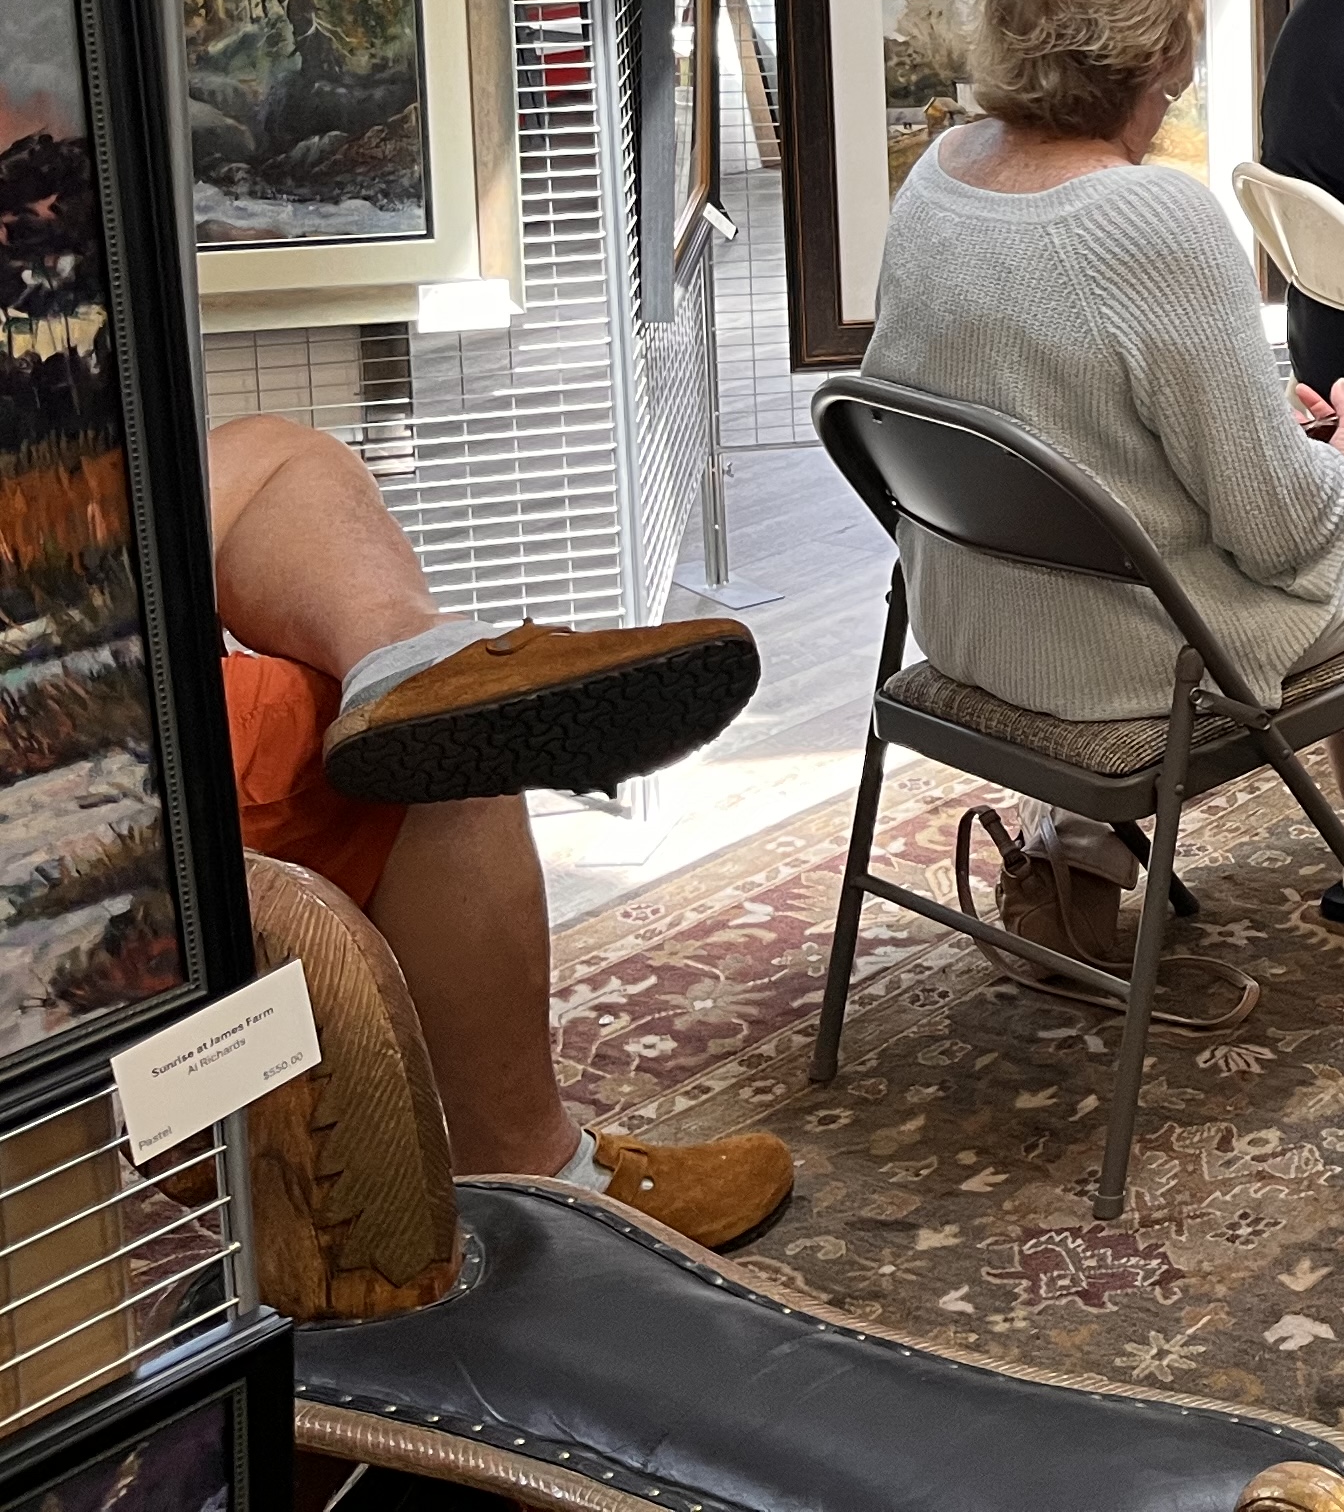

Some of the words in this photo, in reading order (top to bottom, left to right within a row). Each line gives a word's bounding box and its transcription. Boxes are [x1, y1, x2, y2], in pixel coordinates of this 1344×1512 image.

[151, 1051, 194, 1078] Sunrise
[196, 1042, 208, 1054] at
[210, 1023, 244, 1048] James
[245, 1007, 274, 1027] Farm
[187, 1063, 198, 1075] Al
[199, 1038, 246, 1068] Richards
[263, 1051, 304, 1081] $550.00
[138, 1125, 173, 1151] Pastel
